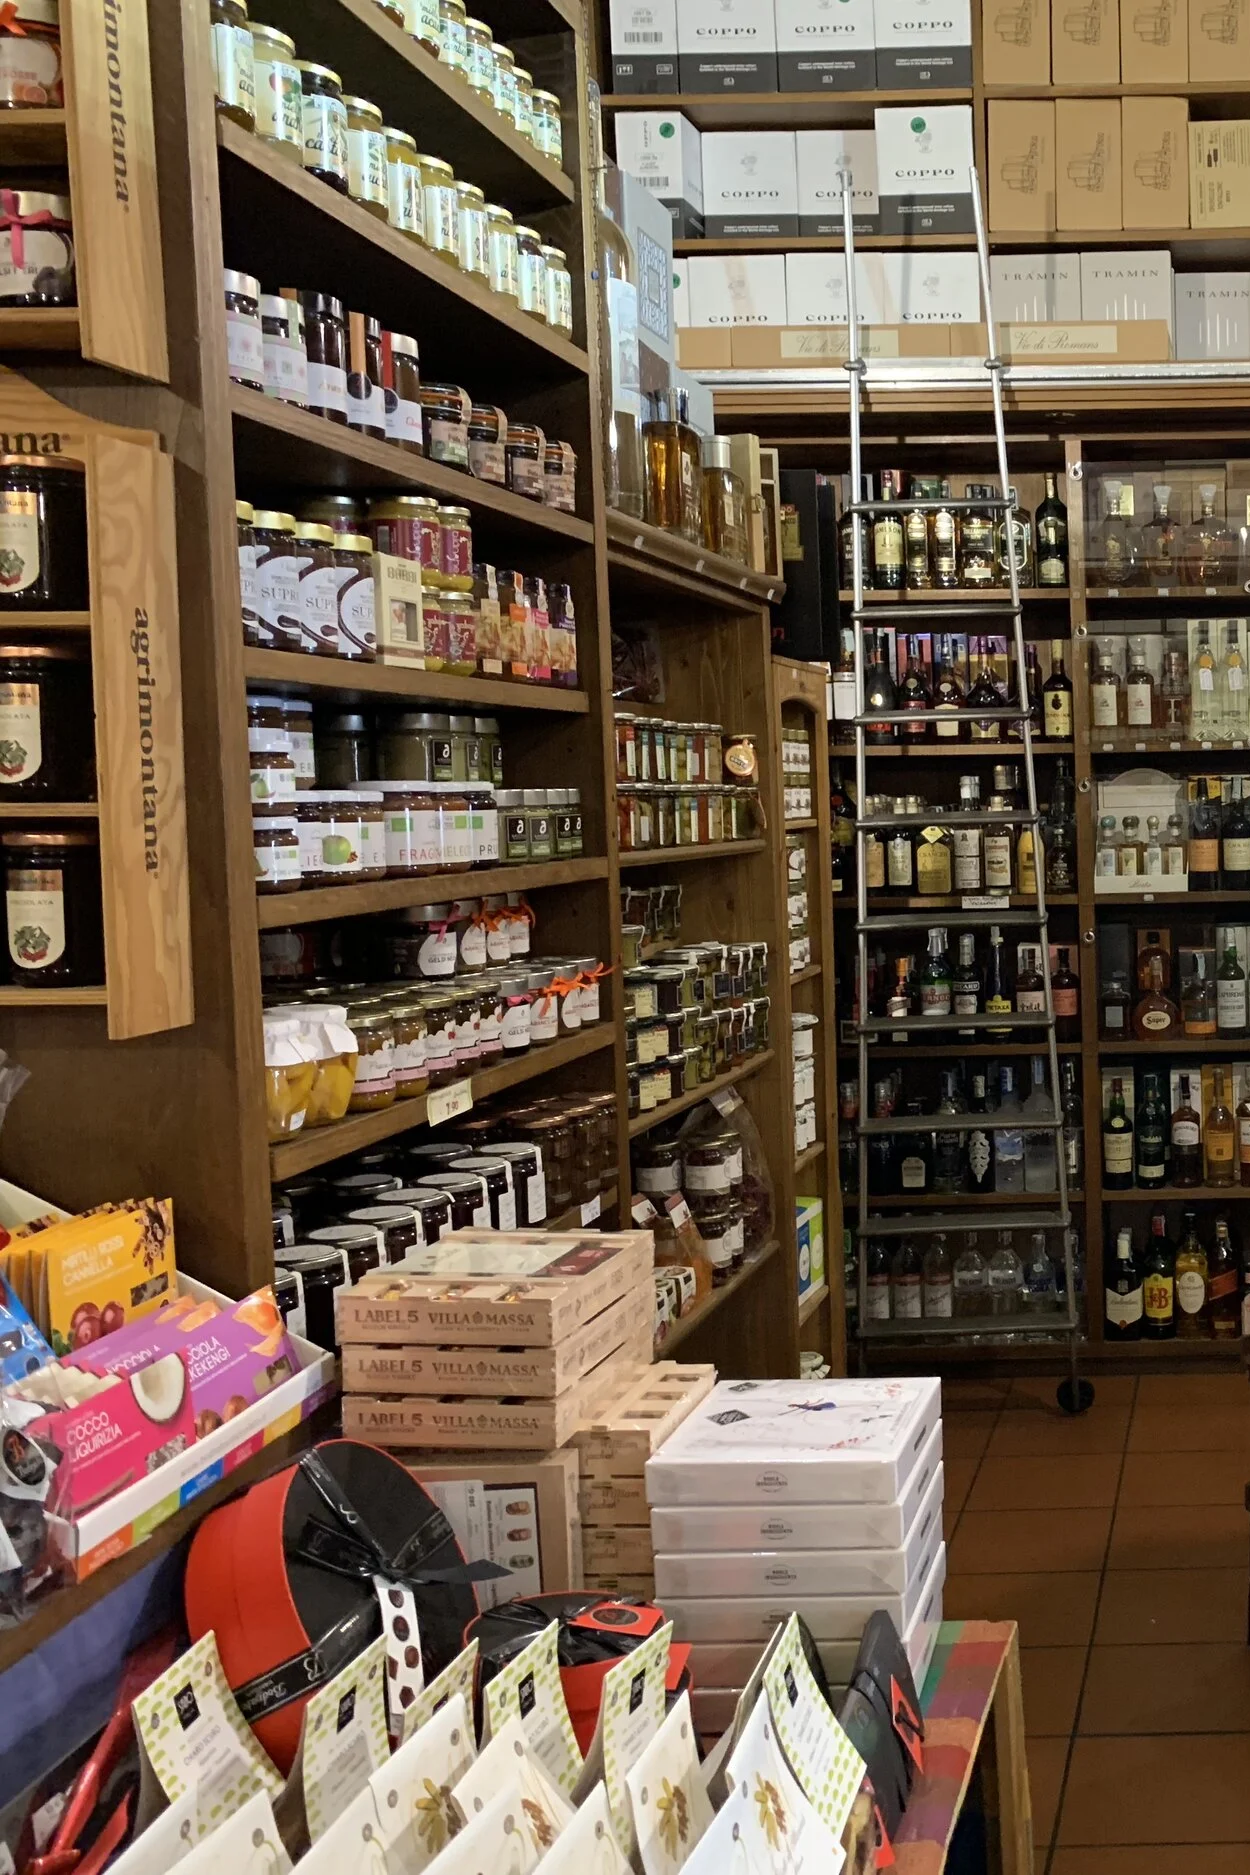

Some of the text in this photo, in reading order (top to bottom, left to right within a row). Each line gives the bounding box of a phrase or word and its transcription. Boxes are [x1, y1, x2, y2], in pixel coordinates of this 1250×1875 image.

[795, 24, 856, 34] COPPO
[893, 21, 953, 30] COPPO
[696, 27, 757, 36] COPPO
[103, 0, 130, 201] imontana
[895, 168, 955, 178] COPPO
[721, 190, 779, 199] COPPO
[1002, 272, 1069, 281] TRAMIN
[1092, 269, 1159, 278] TRAMIN
[1186, 290, 1250, 299] TRAMIN
[708, 313, 768, 323] COPPO
[902, 311, 962, 321] COPPO
[130, 607, 160, 874] agrimontana
[1147, 1016, 1166, 1025] Super
[354, 1310, 418, 1323] LABEL 5
[429, 1312, 535, 1325] VILLA MASSA
[188, 1349, 231, 1382] KEKENGI
[358, 1360, 422, 1373] LABEL 5
[433, 1362, 539, 1376] VILLA MASSA
[358, 1413, 423, 1425] LABEL 5
[433, 1416, 539, 1429] VILLA MASSA
[67, 1412, 109, 1445] COCCO
[68, 1424, 122, 1463] LIQUIRIZIA
